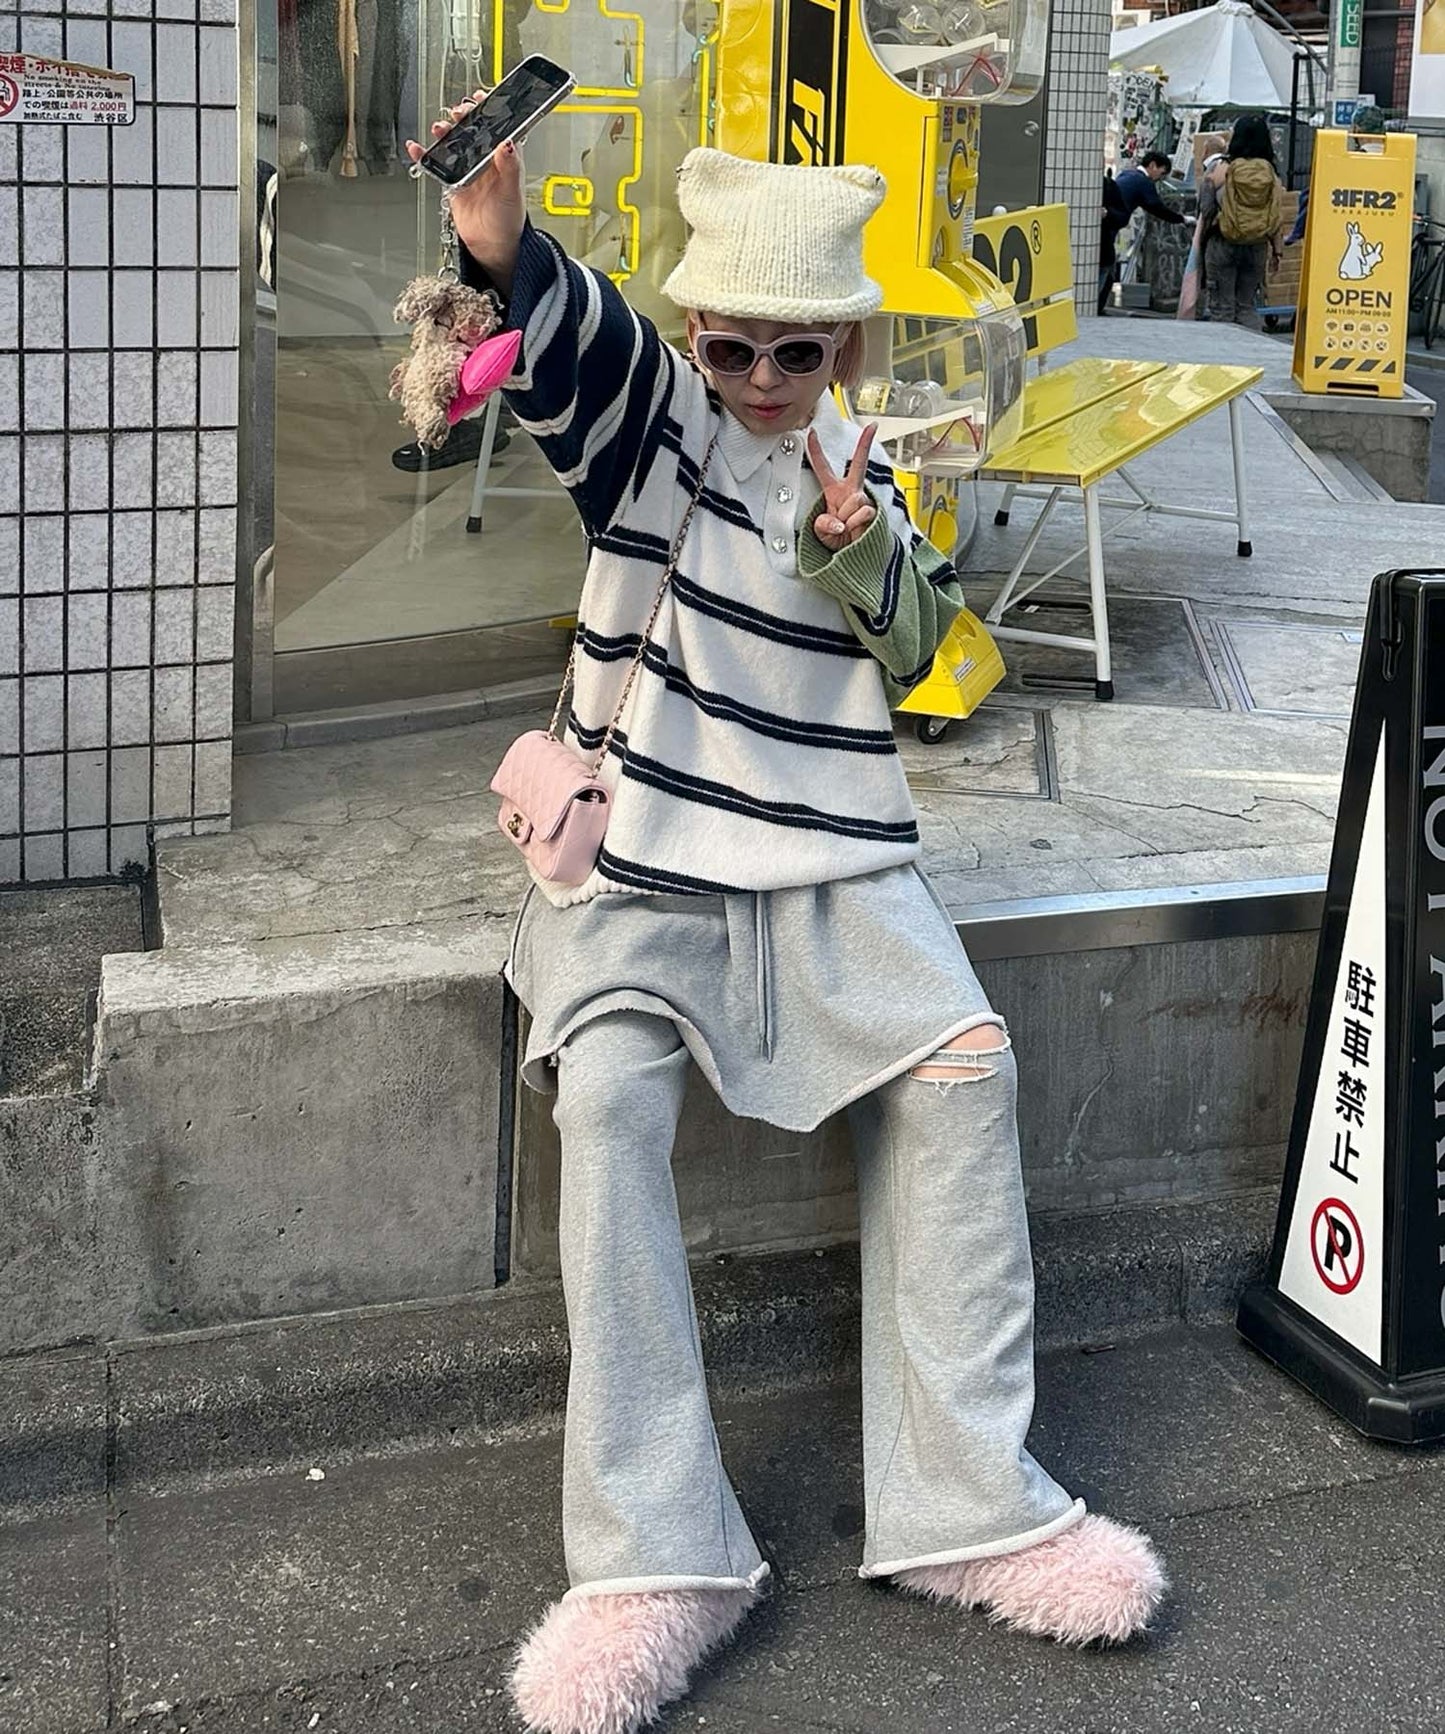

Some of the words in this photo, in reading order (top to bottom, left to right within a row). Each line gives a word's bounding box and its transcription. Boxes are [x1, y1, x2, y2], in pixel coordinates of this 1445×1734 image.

[1346, 3, 1360, 44] SEED
[38, 75, 73, 84] smoking
[94, 113, 128, 123] 渋谷区
[1326, 288, 1392, 308] OPEN
[1330, 960, 1376, 1184] 駐車禁止
